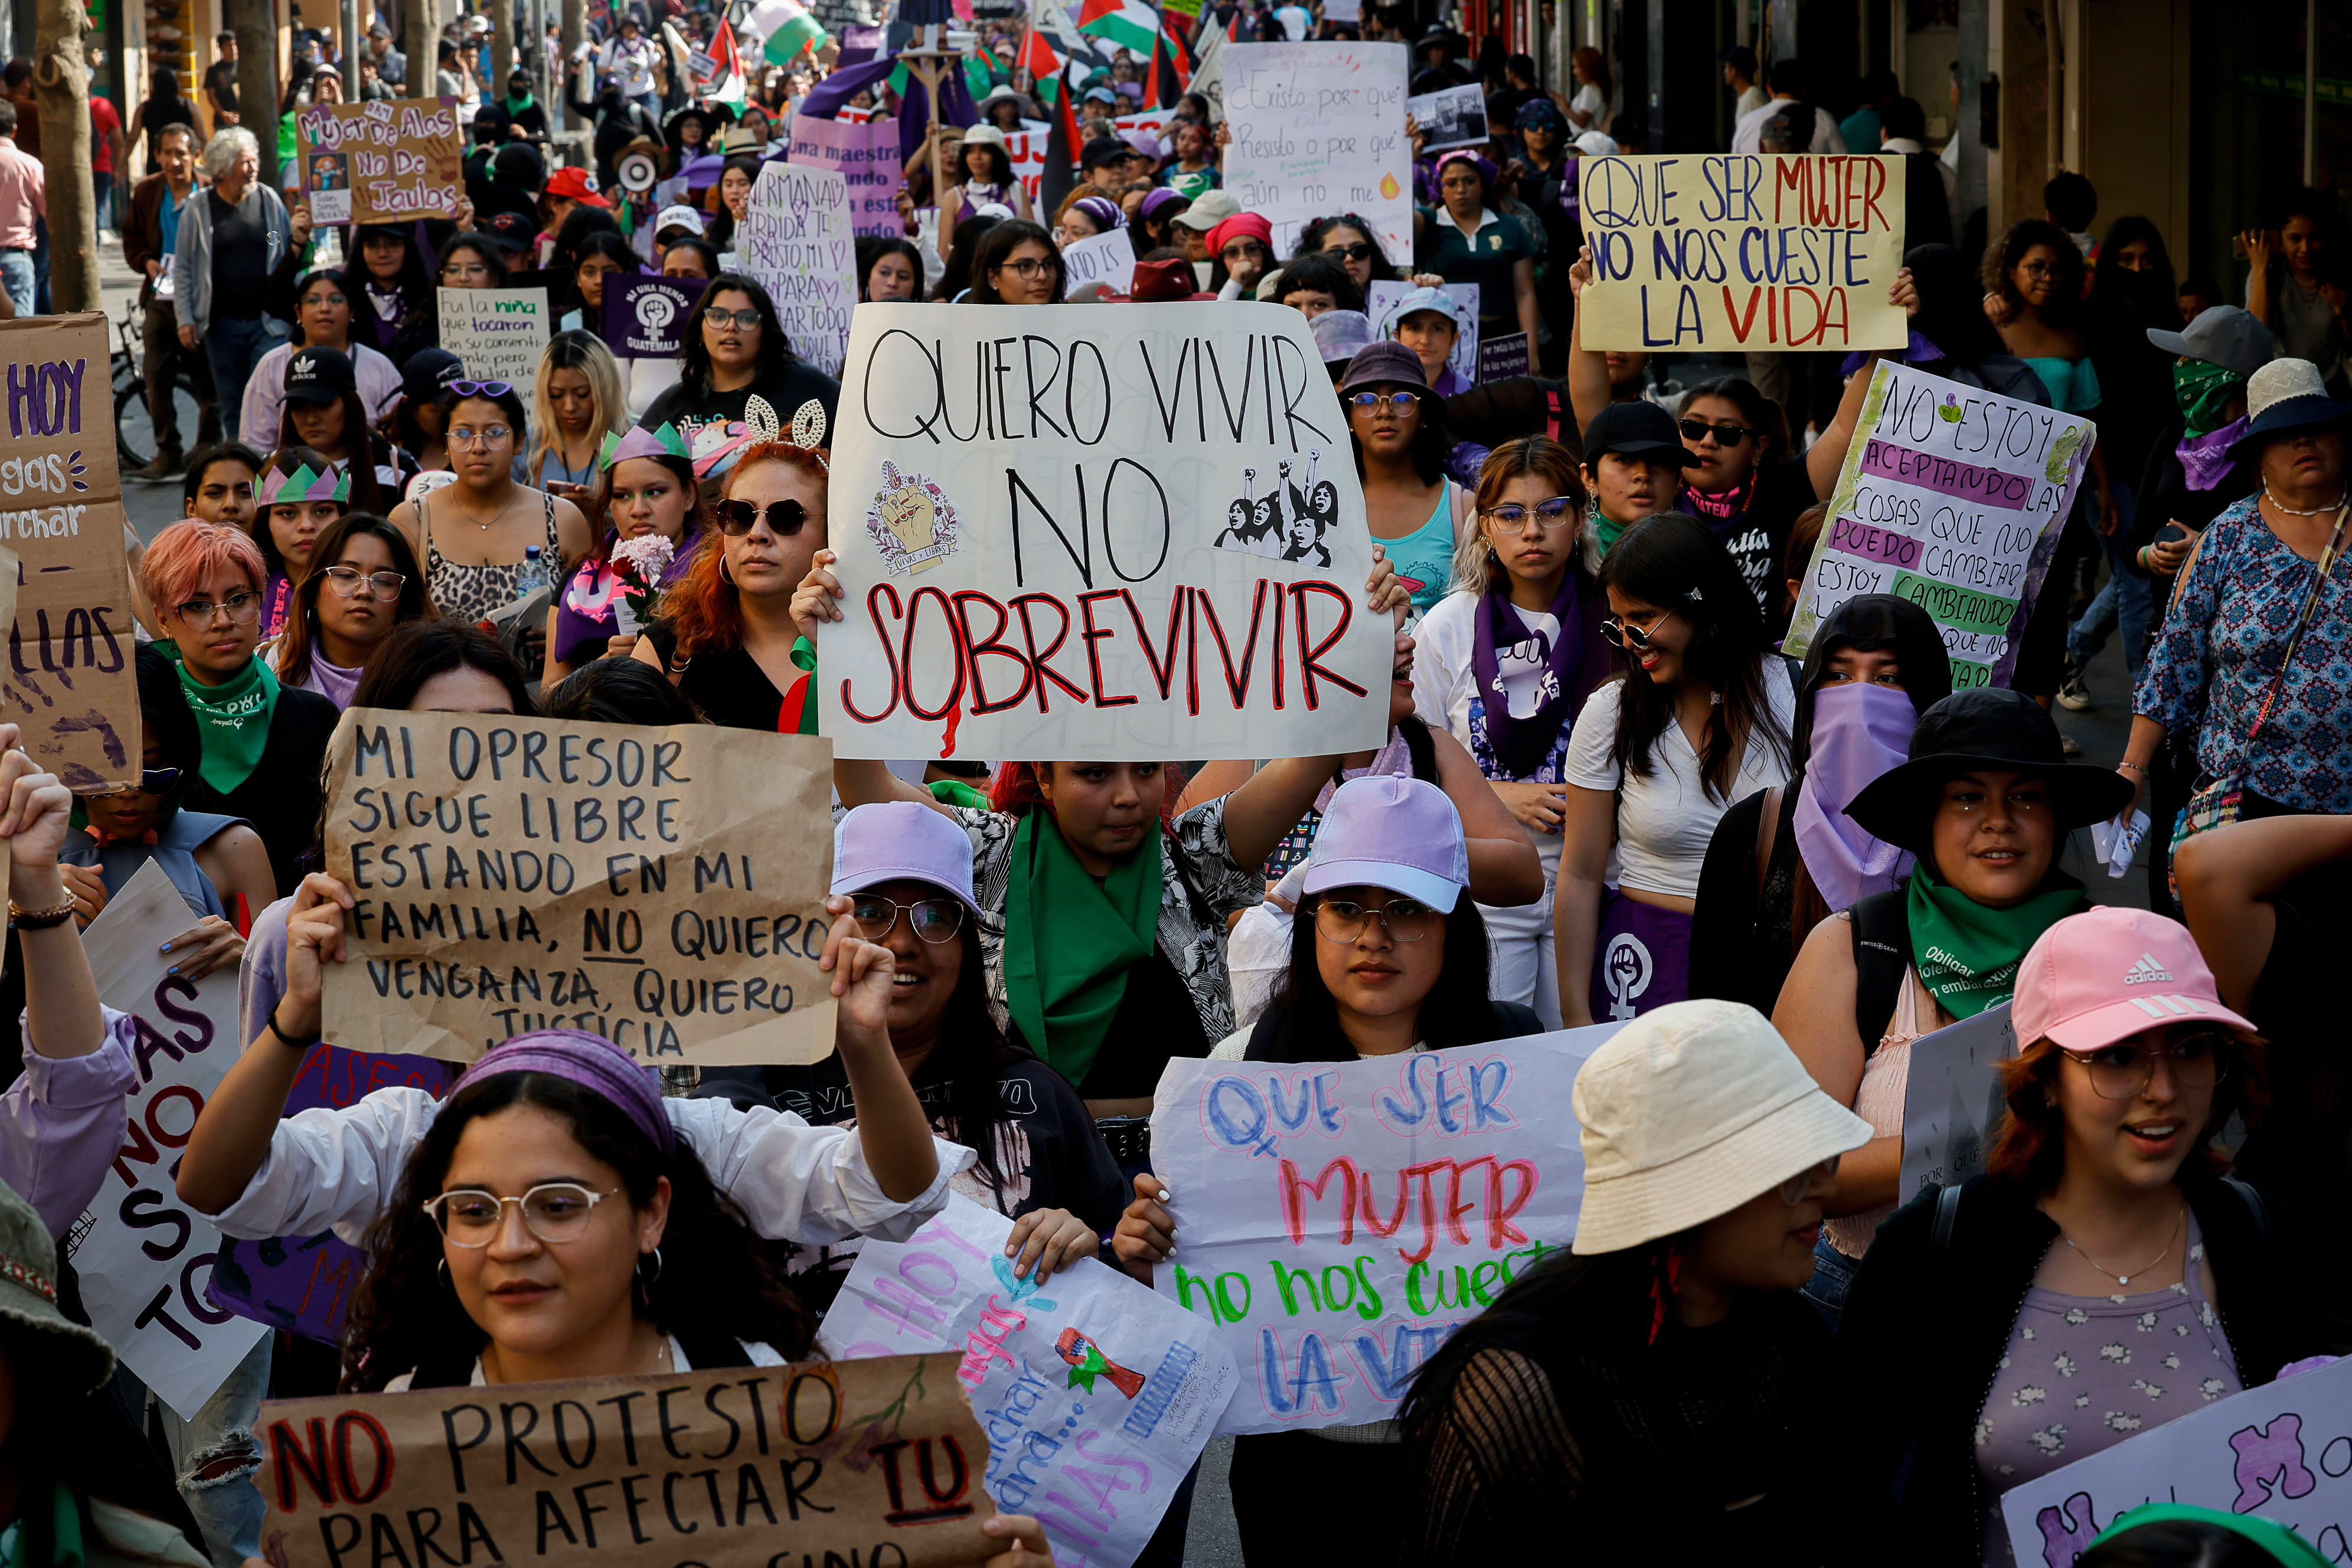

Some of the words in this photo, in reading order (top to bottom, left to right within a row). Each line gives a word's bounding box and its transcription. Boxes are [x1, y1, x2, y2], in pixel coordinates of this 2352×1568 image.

[299, 111, 343, 151] Mujer
[368, 120, 398, 146] De
[400, 106, 455, 138] Alas
[825, 145, 901, 162] maestra
[1237, 123, 1295, 159] Resisto
[1306, 139, 1318, 156] o
[394, 149, 426, 175] De
[369, 178, 456, 211] Jaulas
[1303, 184, 1327, 204] no
[1351, 186, 1374, 204] me
[1584, 156, 1681, 228] QUE
[1700, 155, 1763, 222] SER
[1774, 156, 1891, 232] MUJER
[1588, 230, 1634, 282] NO
[1654, 228, 1727, 285] NOS
[1739, 226, 1870, 287] CUESTE
[469, 292, 489, 314] la
[495, 299, 537, 315] niña
[636, 283, 658, 295] UNA
[658, 284, 690, 308] MENOS
[1641, 283, 1704, 347] LA
[1722, 285, 1850, 347] VIDA
[441, 316, 466, 337] que
[472, 316, 535, 333] tocaron
[626, 335, 681, 352] GUATEMALA
[494, 352, 528, 368] pero
[7, 358, 87, 439] HOY
[863, 328, 1111, 446] QUIERO
[1139, 334, 1332, 453] VIVIR
[1875, 375, 1935, 443] NO
[1954, 398, 2054, 464] ESTOY
[1866, 442, 2027, 501] ACEPTANDO
[2026, 476, 2069, 514] LAS
[1005, 458, 1170, 589] NO
[1831, 515, 1917, 564] PUEDO
[1854, 486, 1921, 526] COSAS
[1931, 505, 1984, 546] QUE
[1993, 523, 2033, 557] NO
[897, 553, 916, 567] VIVAS
[925, 544, 946, 557] LIBRES
[1818, 558, 1881, 592] ESTOY
[840, 579, 1368, 727] SOBREVIVIR
[355, 723, 416, 780] MI
[449, 725, 692, 788] OPRESOR
[349, 786, 492, 838] SIGUE
[520, 792, 681, 845] LIBRE
[351, 841, 574, 896] ESTANDO
[607, 852, 667, 897] EN
[694, 852, 755, 894] MI
[353, 898, 558, 952] FAMILIA,
[583, 907, 644, 956] NO
[671, 908, 829, 962] QUIERO
[1883, 945, 1898, 953] GEAR
[365, 959, 612, 1014] VENGANZA,
[633, 968, 794, 1016] QUIERO
[2124, 970, 2173, 985] adidas
[112, 1083, 205, 1189] NO
[1198, 1065, 1348, 1161] QUE
[1371, 1051, 1521, 1139] SER
[1920, 1167, 1943, 1188] POR
[1278, 1153, 1541, 1266] MUJER
[862, 1214, 989, 1342] HOY
[1174, 1262, 1252, 1328] no
[1269, 1256, 1383, 1320] nos
[1255, 1322, 1352, 1420] LA
[267, 1408, 395, 1514] NO
[441, 1371, 841, 1494] PROTESTO
[319, 1501, 505, 1568] PARA
[534, 1457, 836, 1556] AFECTAR
[868, 1434, 972, 1518] TU
